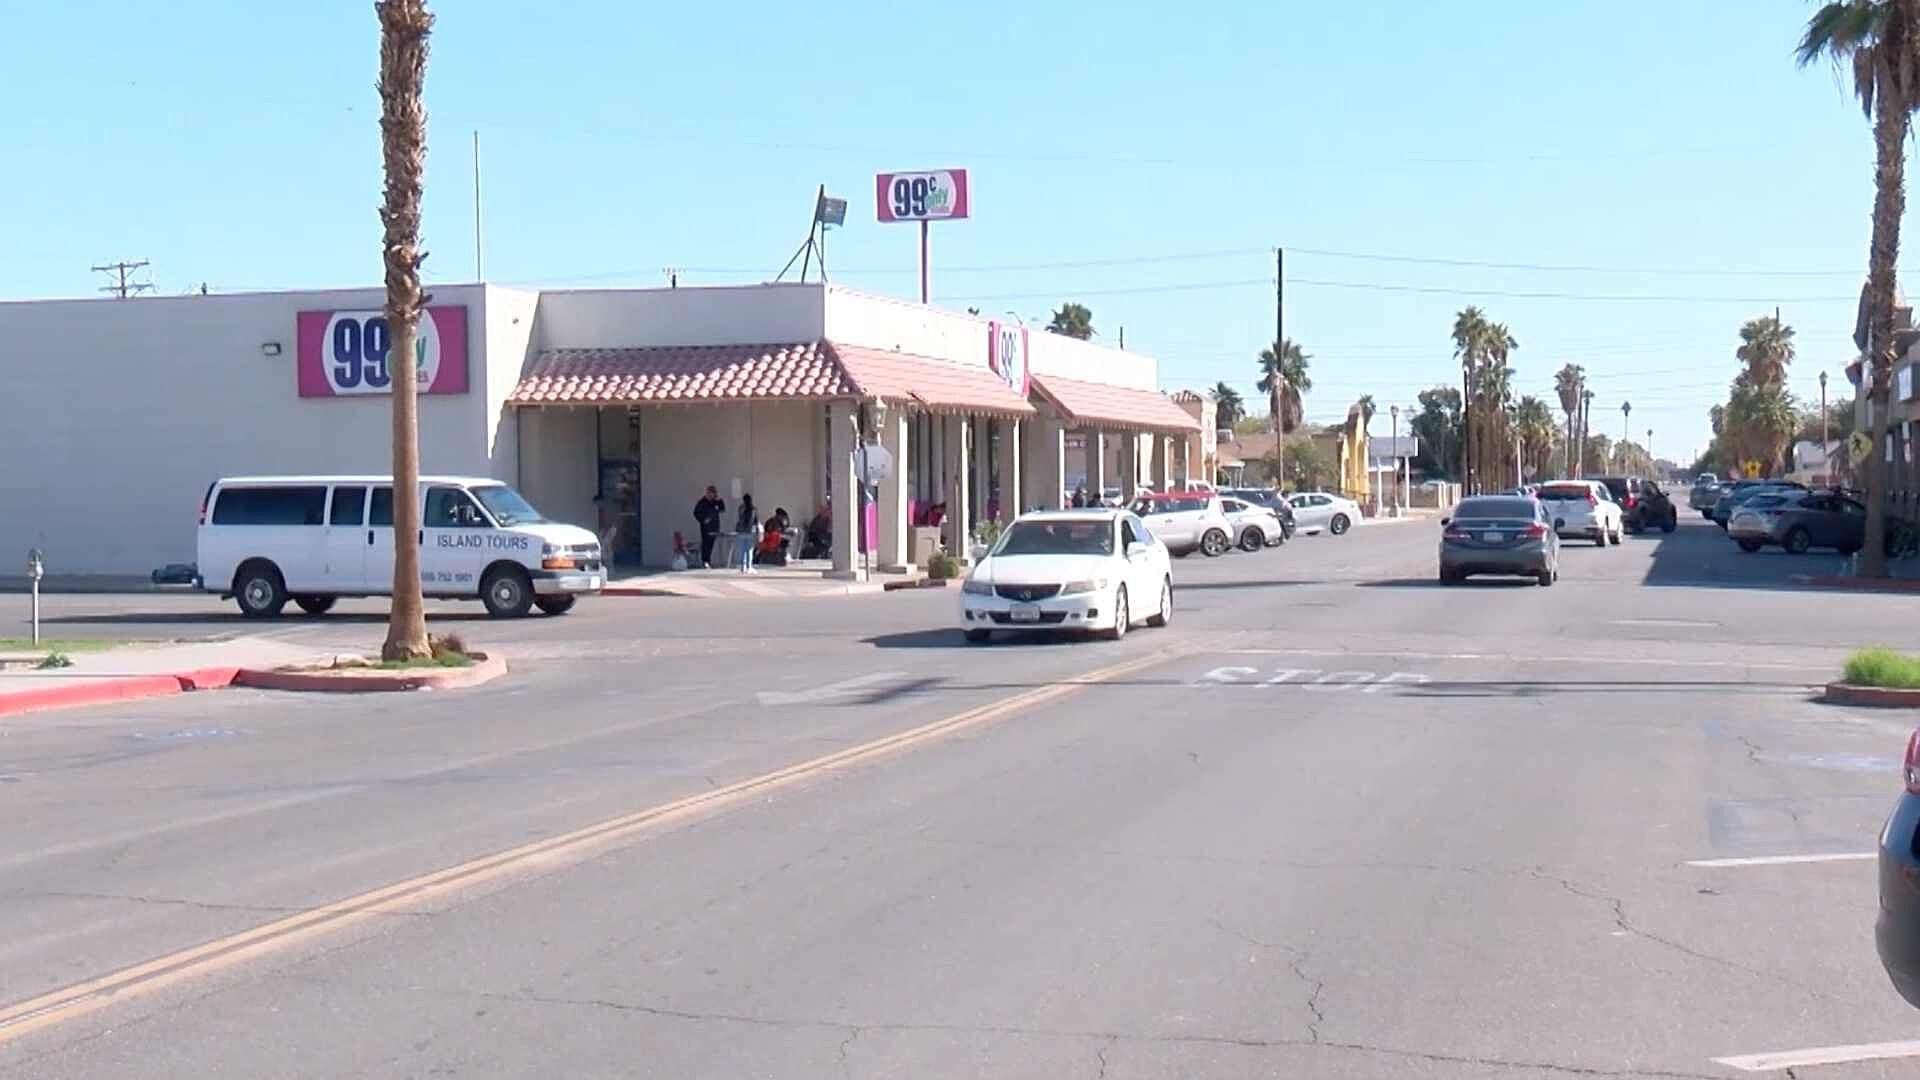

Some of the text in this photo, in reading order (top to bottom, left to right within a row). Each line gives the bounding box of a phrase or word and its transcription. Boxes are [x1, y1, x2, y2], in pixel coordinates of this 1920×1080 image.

[334, 318, 391, 388] 99
[437, 535, 529, 550] ISLAND TOURS
[1194, 665, 1434, 692] STOP
